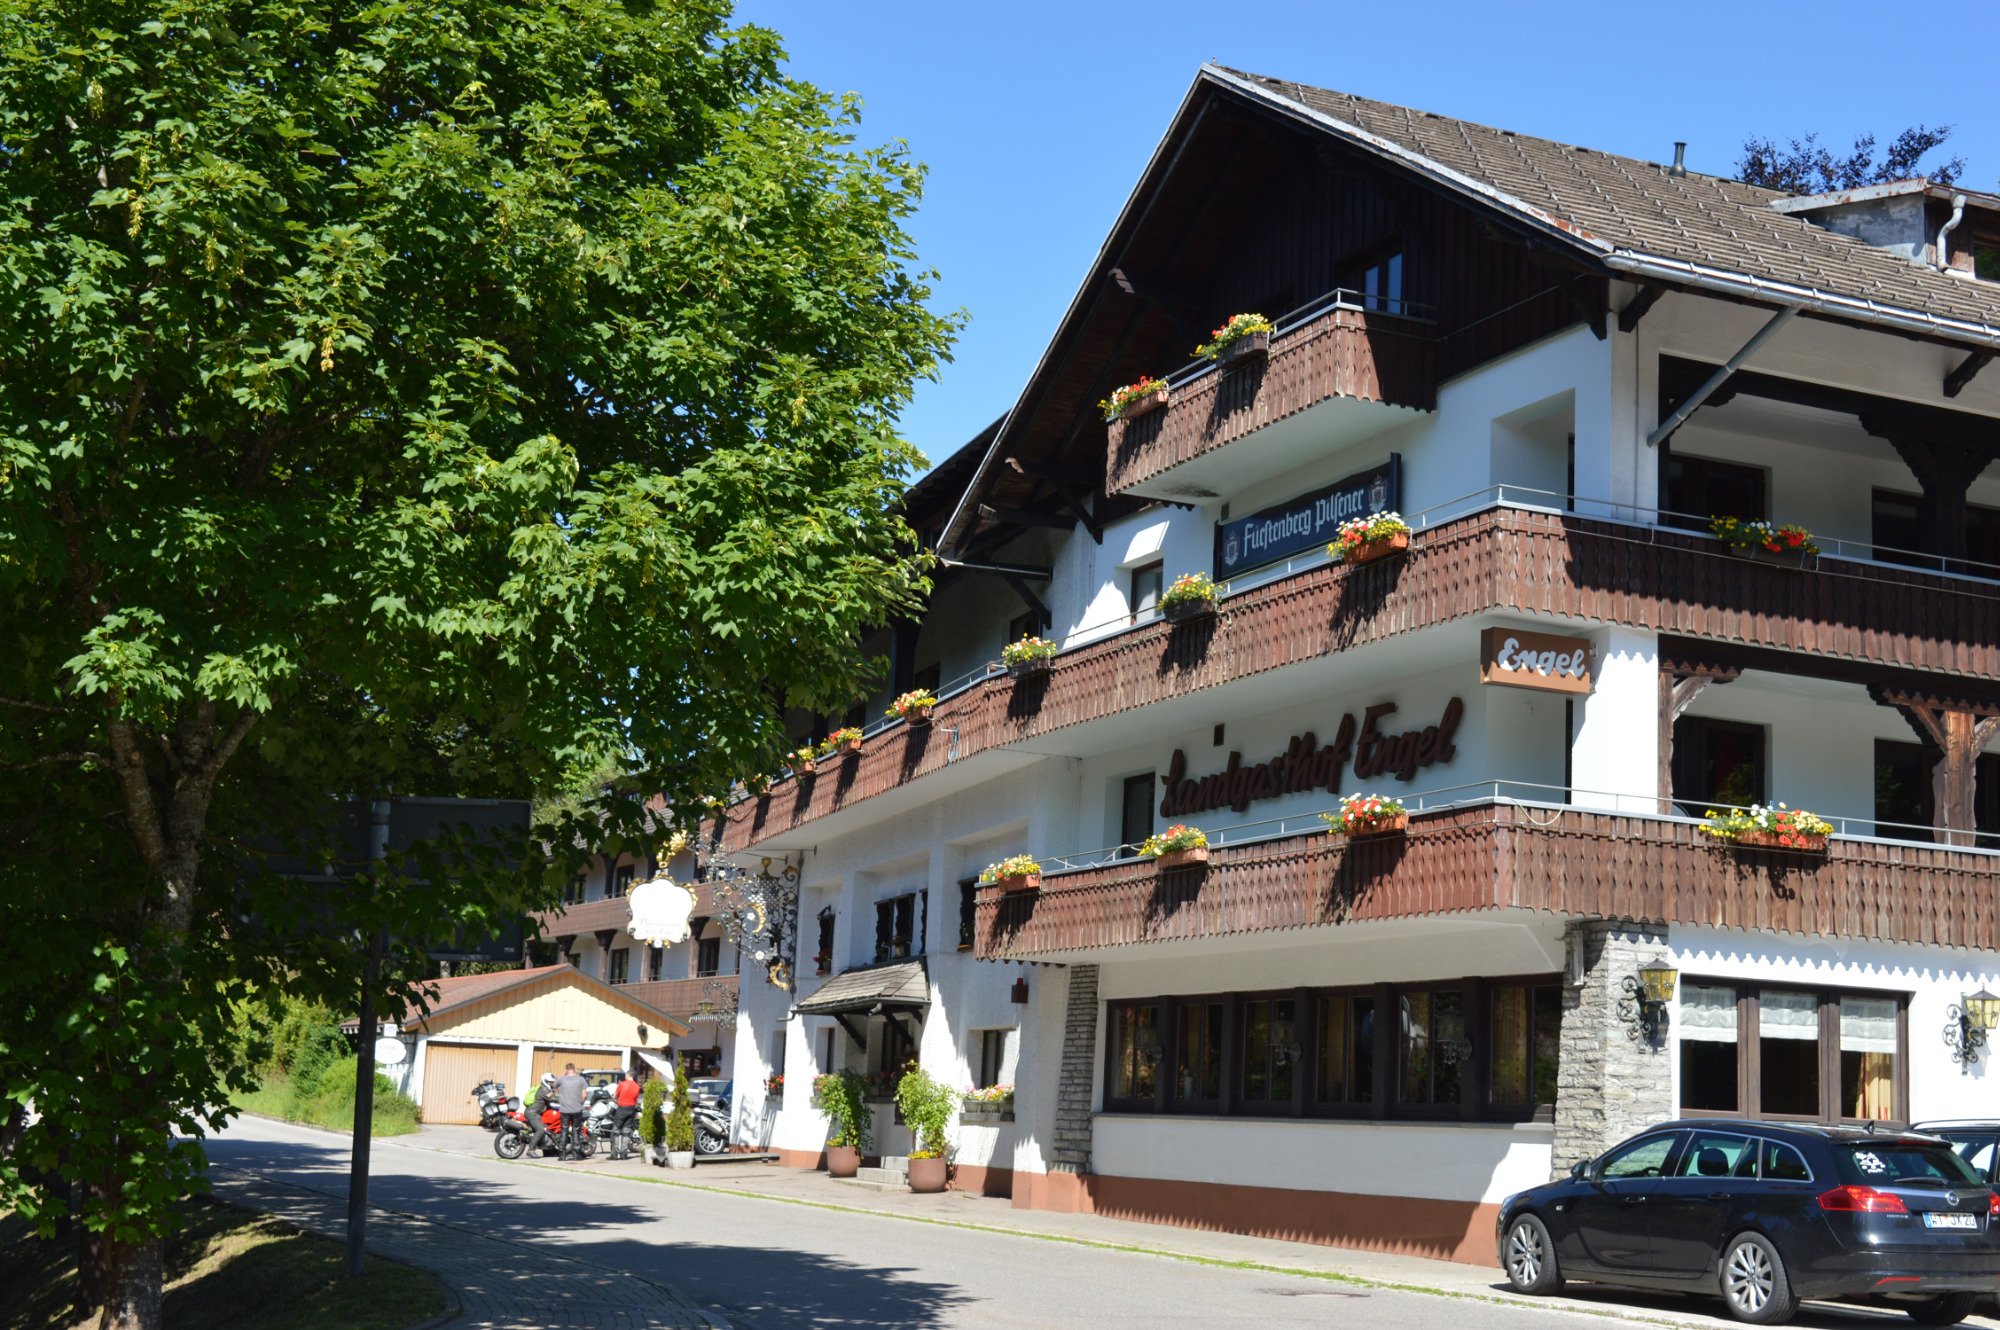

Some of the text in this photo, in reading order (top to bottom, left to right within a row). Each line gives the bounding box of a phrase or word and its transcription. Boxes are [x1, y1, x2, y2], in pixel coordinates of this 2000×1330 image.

[1498, 637, 1585, 678] Engel
[1160, 696, 1464, 818] Landgasthof Engel
